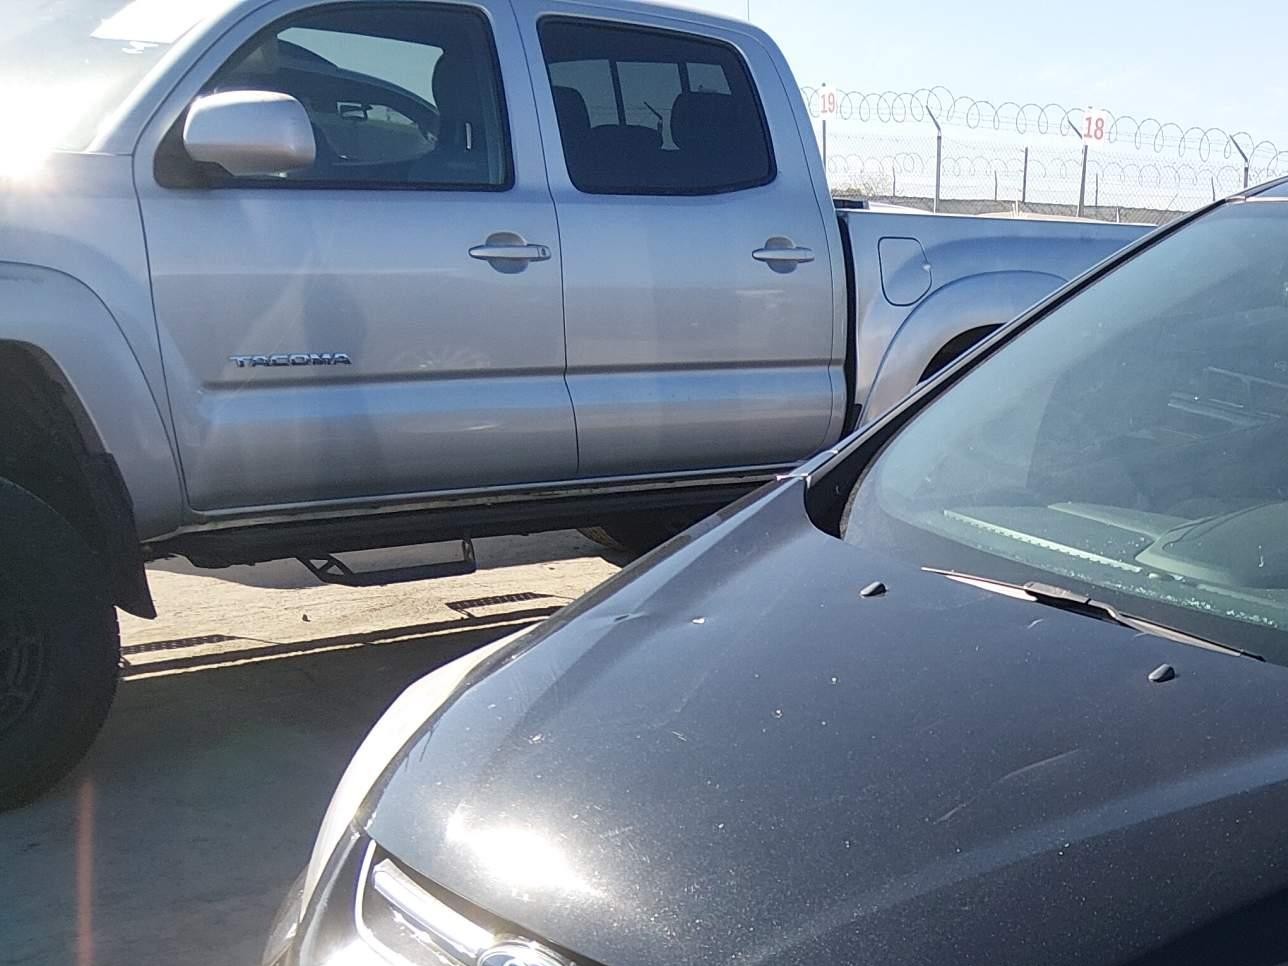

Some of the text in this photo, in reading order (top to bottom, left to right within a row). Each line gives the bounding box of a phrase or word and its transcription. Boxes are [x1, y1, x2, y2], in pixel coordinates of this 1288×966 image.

[820, 92, 836, 114] 19
[1083, 116, 1105, 140] 18
[229, 352, 353, 368] TACOMA
